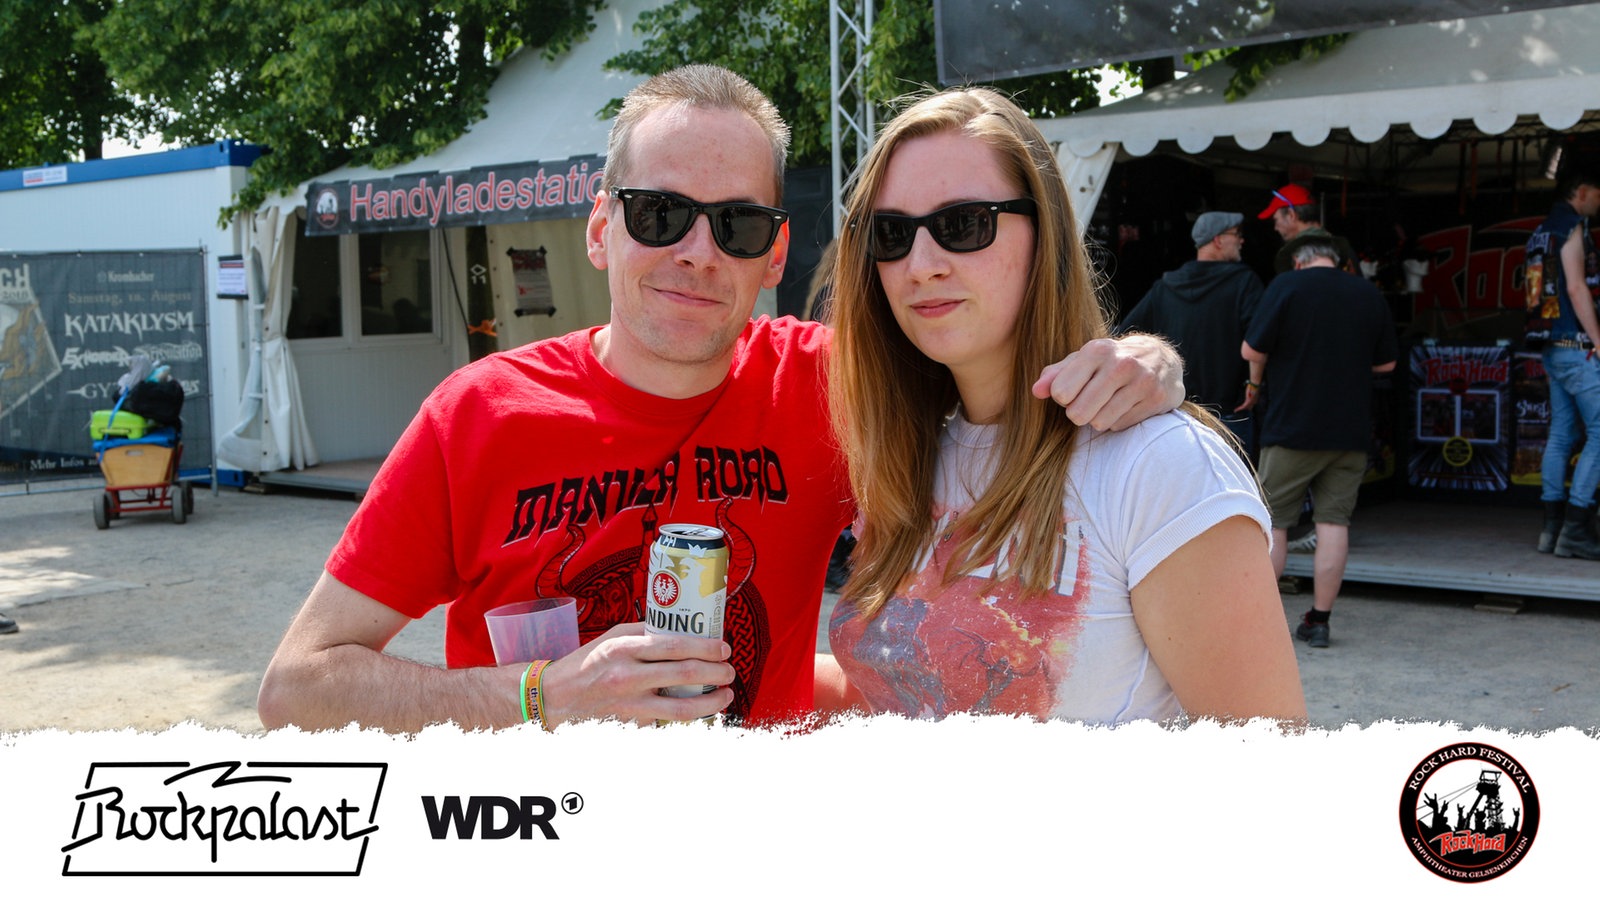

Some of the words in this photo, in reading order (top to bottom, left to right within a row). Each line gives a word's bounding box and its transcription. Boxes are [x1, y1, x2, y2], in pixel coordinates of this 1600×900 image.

[349, 163, 603, 226] Handyladestatio
[108, 270, 155, 282] Krombacher
[64, 311, 195, 343] KATAKLYSM
[694, 445, 790, 514] ROAD
[646, 606, 705, 635] NDING
